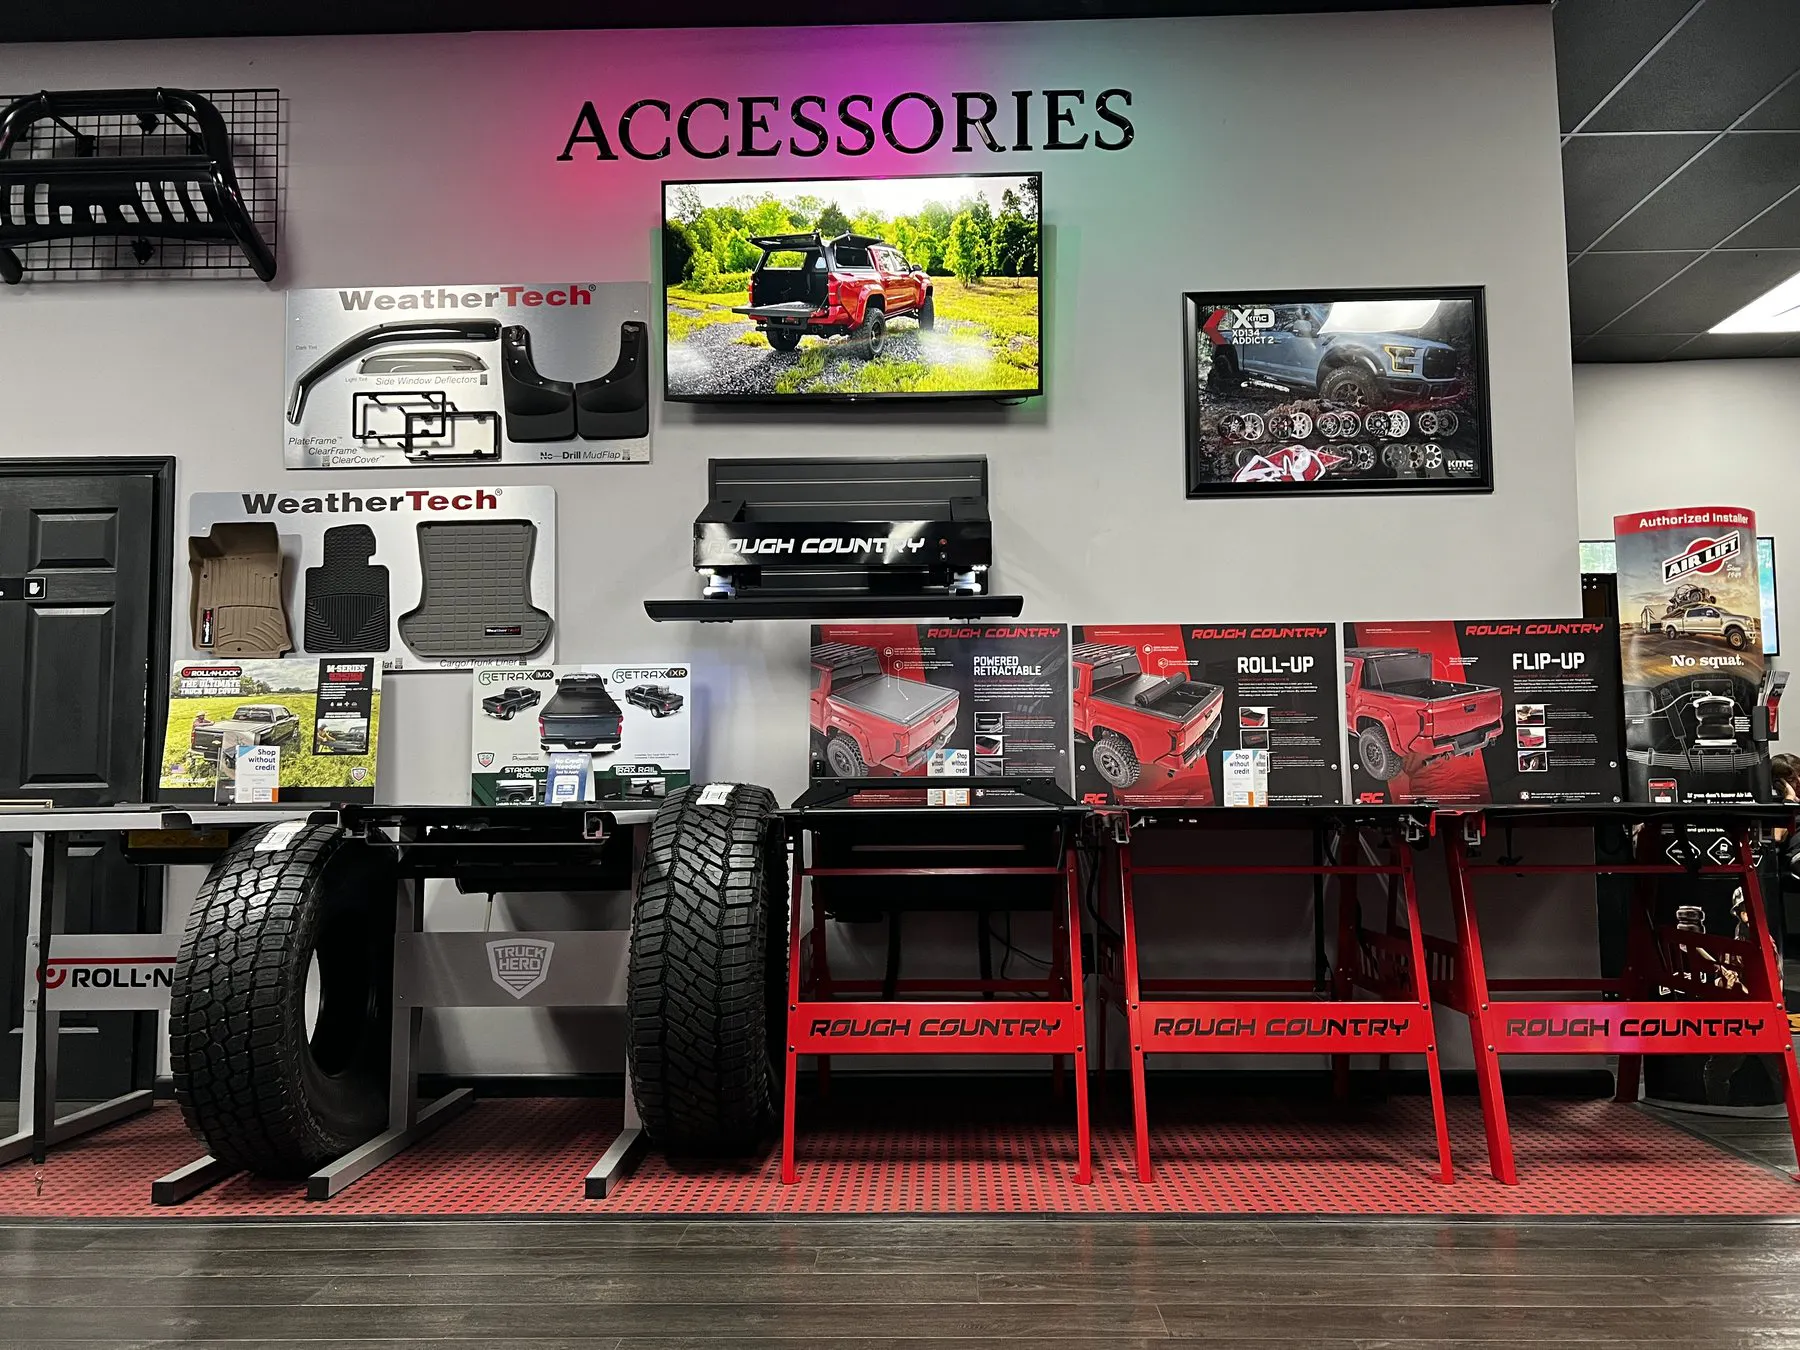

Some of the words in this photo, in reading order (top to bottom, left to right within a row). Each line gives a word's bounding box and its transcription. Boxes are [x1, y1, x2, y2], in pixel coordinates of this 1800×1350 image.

[556, 88, 1136, 162] ACCESSORIES
[1231, 309, 1275, 328] XD
[1232, 336, 1266, 345] ADDICT
[1268, 336, 1274, 344] 2
[375, 377, 395, 386] Side
[398, 376, 431, 385] Window
[434, 375, 478, 384] Deflectors
[308, 447, 358, 456] ClearFrame
[582, 450, 621, 460] MudFlap
[1447, 460, 1473, 468] KMC
[1639, 513, 1710, 528] Authorized
[1712, 512, 1749, 525] Installer
[800, 538, 925, 554] COUNTRY
[1668, 554, 1701, 578] AIR
[1705, 537, 1737, 562] LIFT
[927, 628, 981, 639] ROUGH
[986, 627, 1060, 638] COUNTRY
[1191, 628, 1246, 640] ROUGH
[1250, 627, 1327, 639] COUNTRY
[1465, 625, 1521, 636] ROUGH
[1525, 623, 1603, 635] COUNTRY
[495, 658, 518, 666] Liner
[973, 656, 1019, 666] POWERED
[1237, 656, 1314, 674] ROLL-UP
[1512, 652, 1585, 670] FLIP-UP
[1670, 655, 1695, 667] No
[1699, 654, 1745, 669] squat.
[613, 670, 667, 682] RETRAX
[973, 666, 1042, 676] RETRACTABLE
[479, 671, 533, 684] RETRAX
[180, 680, 198, 688] THE
[199, 680, 241, 688] ULTIMATE
[180, 687, 203, 695] TRUCK
[203, 687, 218, 695] BED
[218, 687, 241, 695] COVER
[257, 748, 277, 757] Shop
[1235, 753, 1250, 761] Shop
[1229, 760, 1250, 768] without
[1083, 793, 1108, 804] RC
[1360, 792, 1384, 804] RC
[495, 946, 545, 959] TRUCK
[499, 957, 541, 971] HERO
[810, 1018, 912, 1037] ROUGH
[918, 1018, 1061, 1037] COUNTRY
[1153, 1017, 1257, 1037] ROUGH
[1265, 1017, 1410, 1037] COUNTRY
[1505, 1018, 1609, 1037] ROUGH
[1619, 1018, 1764, 1037] COUNTRY
